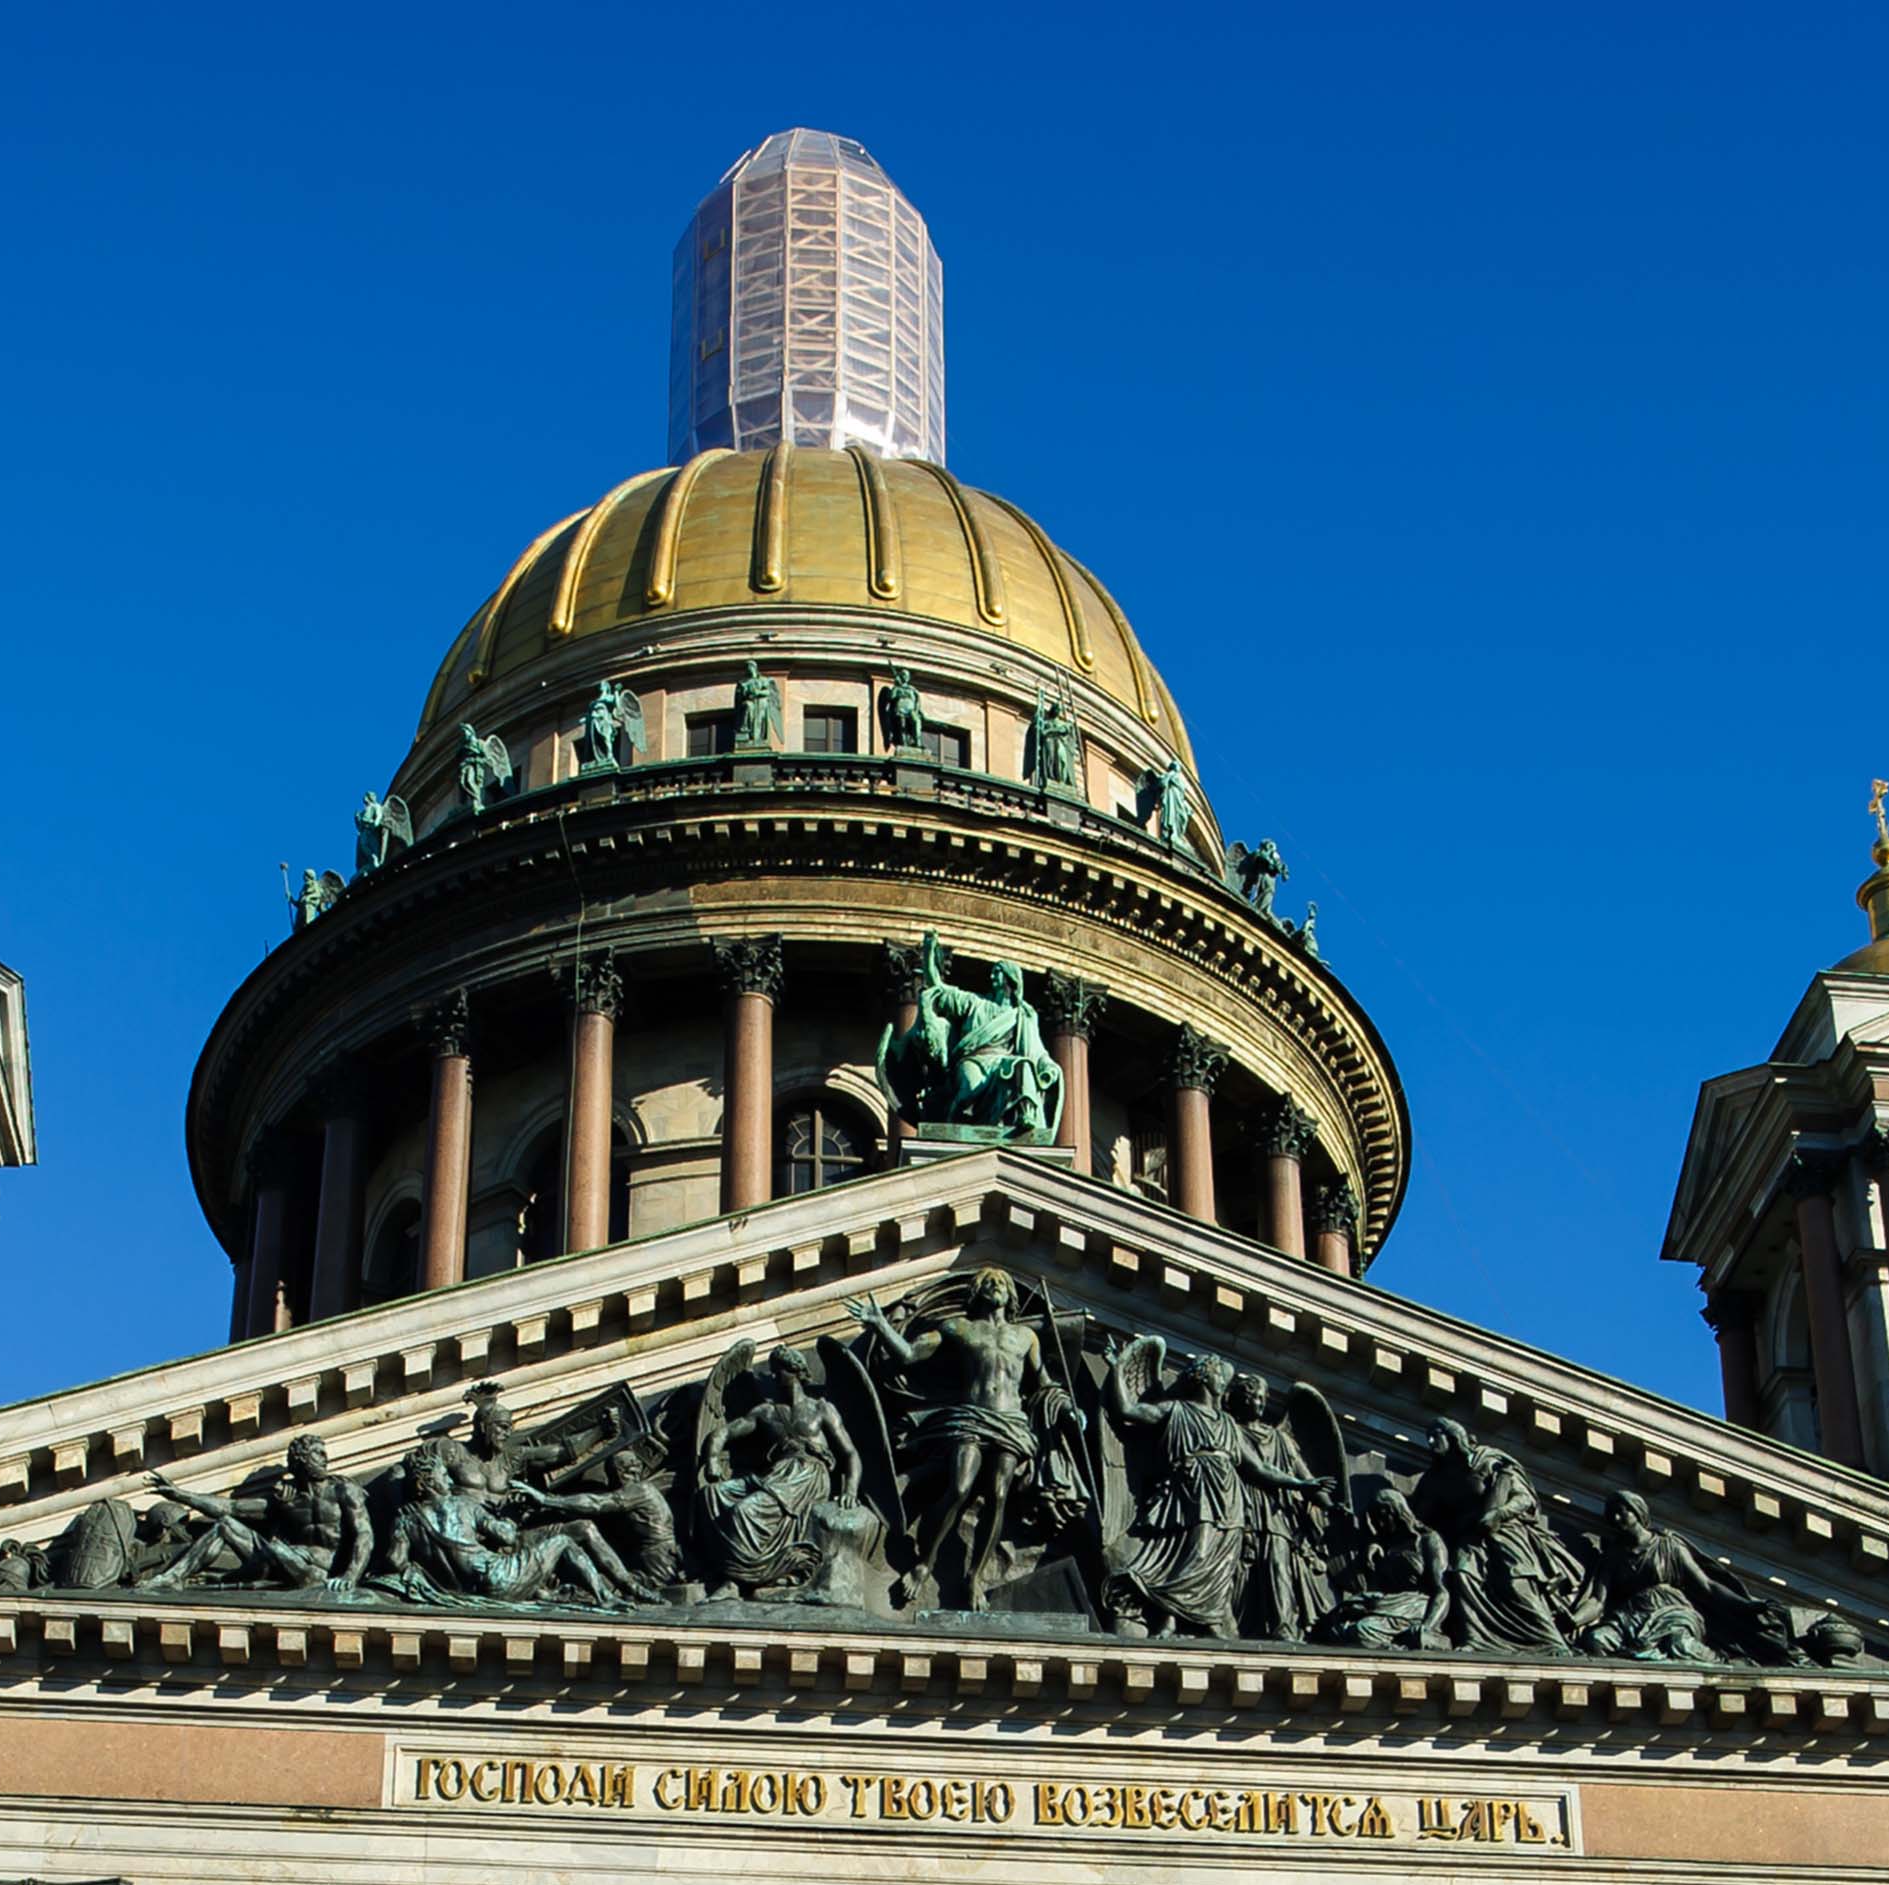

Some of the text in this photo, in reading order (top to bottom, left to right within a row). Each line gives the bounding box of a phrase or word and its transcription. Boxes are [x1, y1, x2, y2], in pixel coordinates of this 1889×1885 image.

[414, 1757, 636, 1810] ГОСПОДИ
[652, 1767, 828, 1816] СИЛОЮ
[839, 1774, 1015, 1824] ТВОЕЮ
